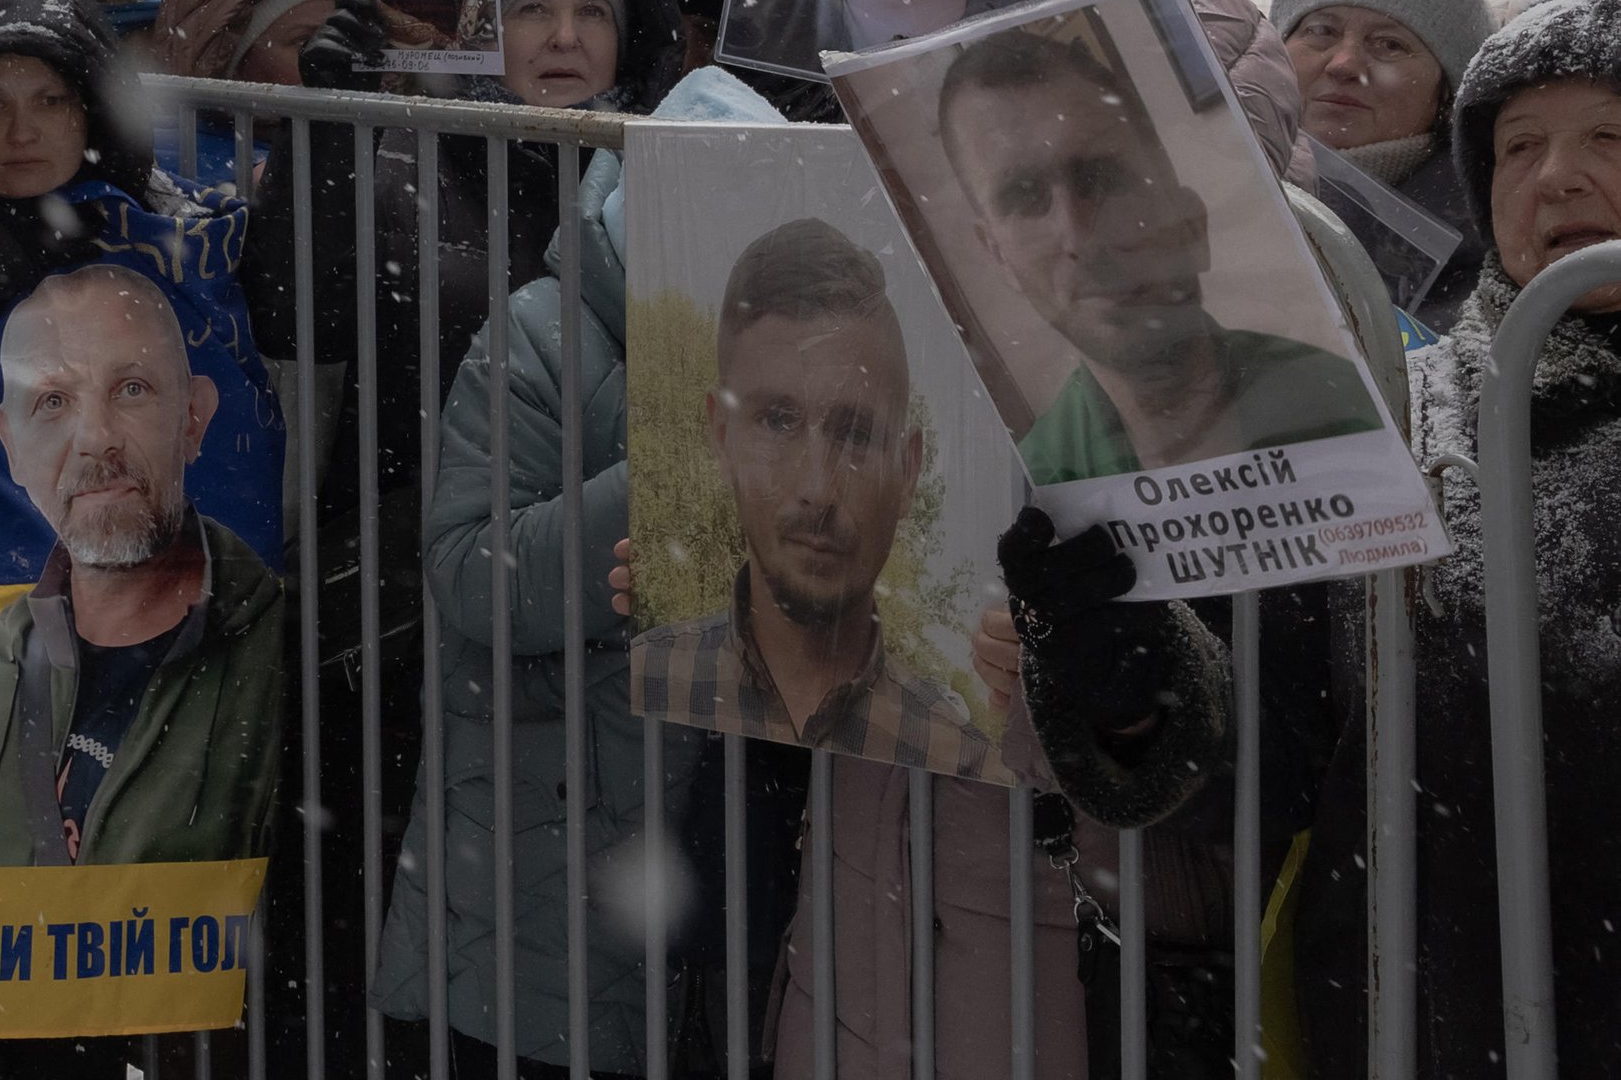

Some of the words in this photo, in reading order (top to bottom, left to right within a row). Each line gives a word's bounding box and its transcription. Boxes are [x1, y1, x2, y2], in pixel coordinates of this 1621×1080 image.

[1134, 449, 1297, 506] Олексій
[1108, 493, 1355, 553] Прохоренко
[1318, 511, 1428, 548] (0639709532
[1166, 534, 1327, 584] ШУТНІК
[1337, 537, 1428, 566] Людмила)
[47, 906, 155, 980] ТВІЙ
